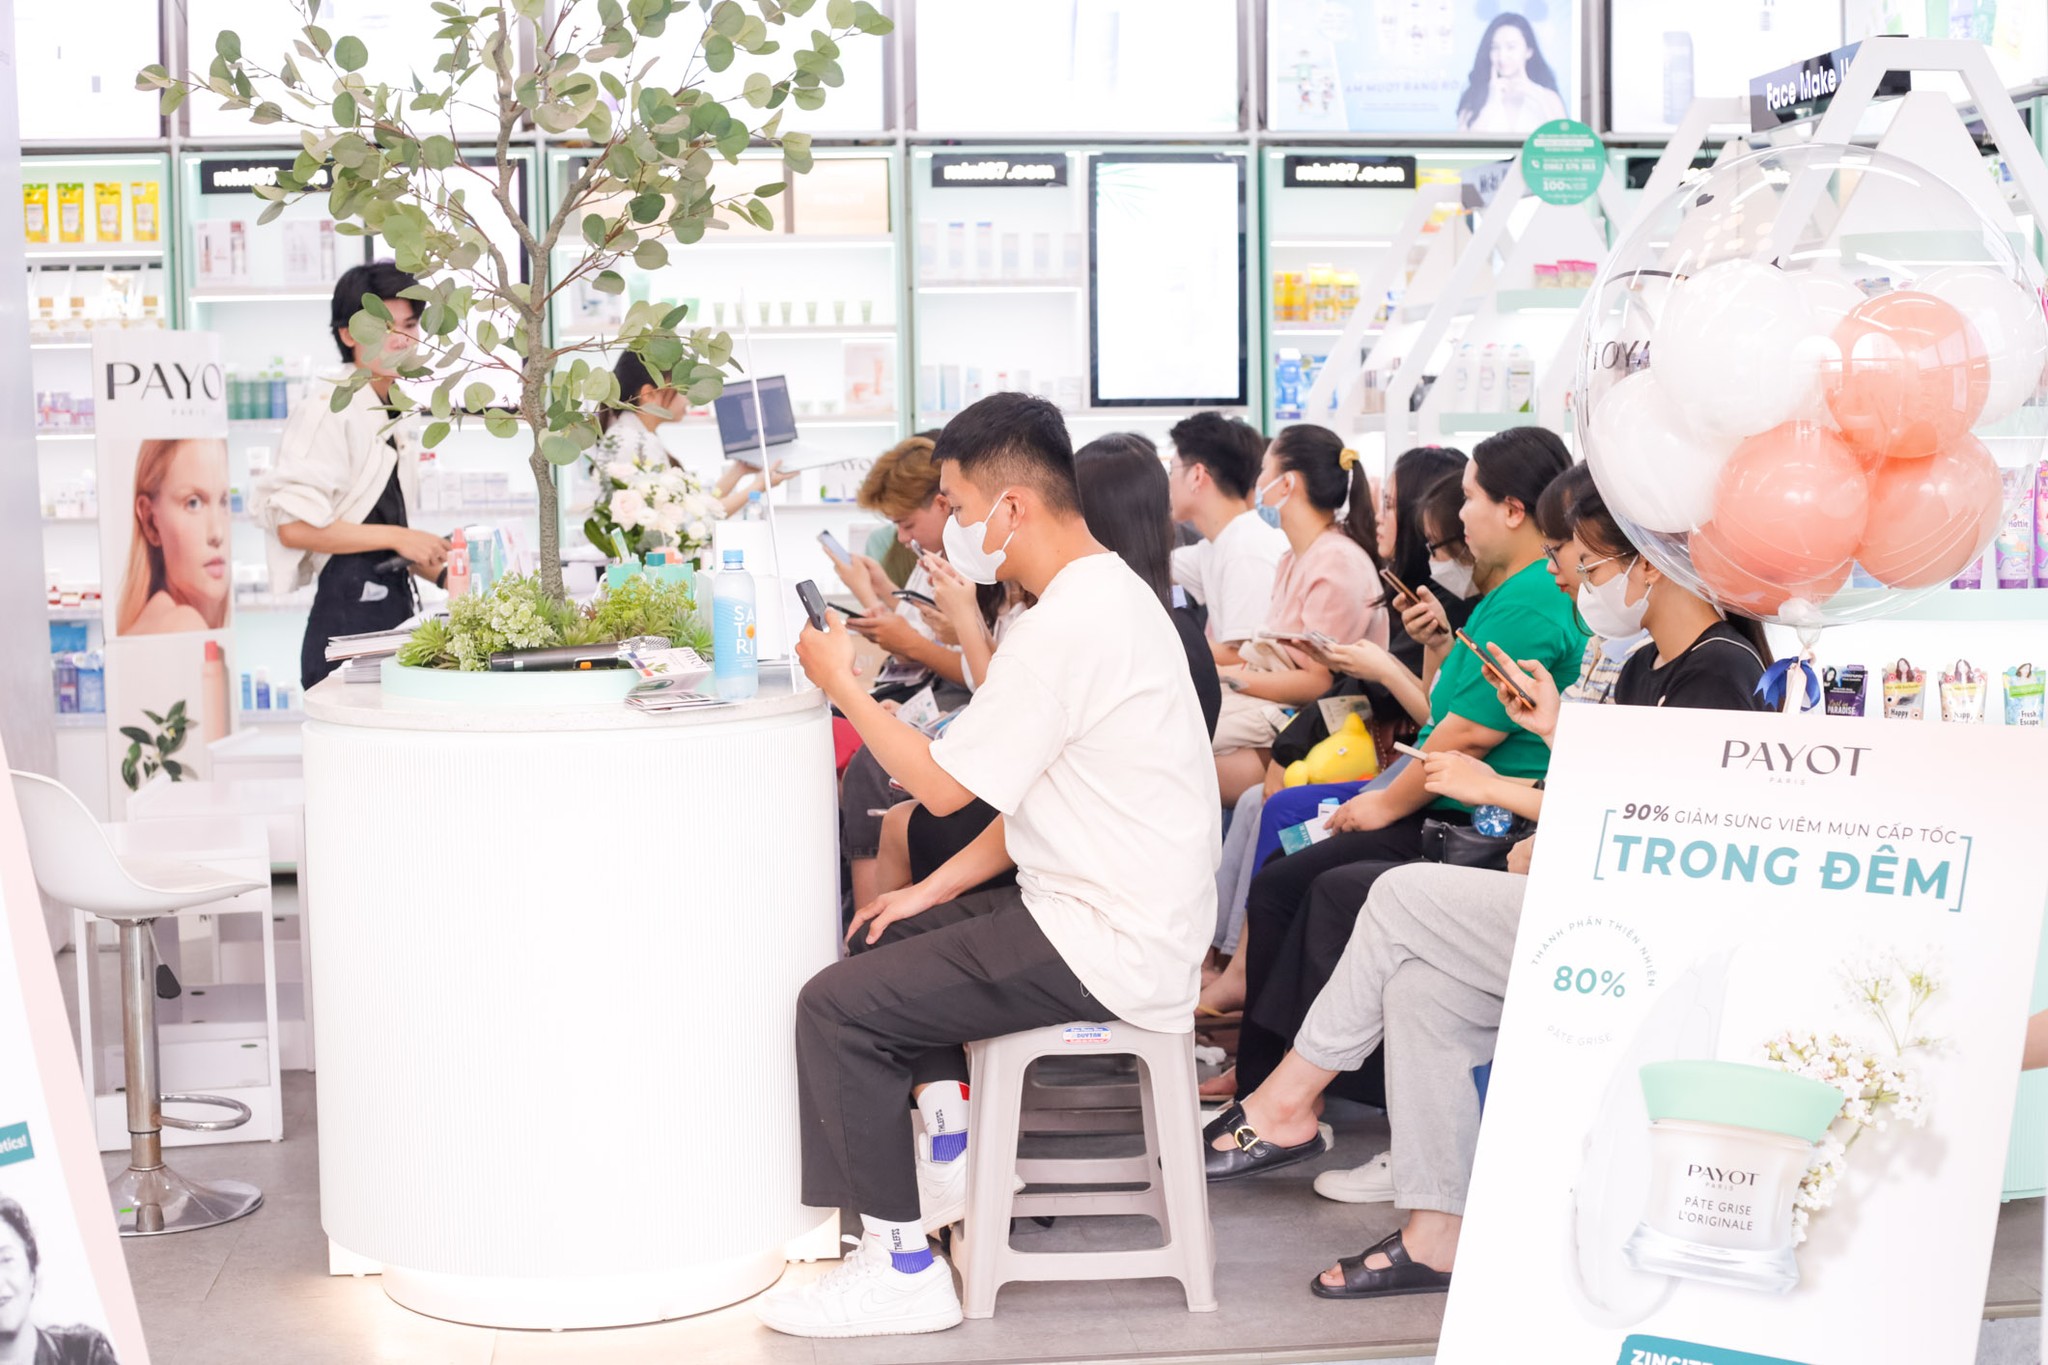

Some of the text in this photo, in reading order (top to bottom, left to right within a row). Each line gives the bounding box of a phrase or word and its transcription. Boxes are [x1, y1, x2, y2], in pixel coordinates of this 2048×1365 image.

[1766, 80, 1797, 111] Face
[1800, 64, 1837, 101] Make
[1890, 708, 1909, 718] Happy
[2020, 718, 2039, 726] Escape
[1721, 740, 1872, 776] PAYOT
[1769, 777, 1806, 785] PARIS
[1623, 803, 1957, 844] 90% GIẢM SƯNG VIÊM MỤN CẤP TỐC
[1613, 834, 1950, 900] TRONG ĐÊM
[1553, 965, 1626, 998] 80%
[1577, 1032, 1613, 1047] GRISE
[1687, 1163, 1760, 1187] PAYOT
[1705, 1181, 1734, 1191] PARIS
[1684, 1195, 1752, 1216] PÂTE GRISE
[1678, 1210, 1753, 1231] L'ORIGINALE
